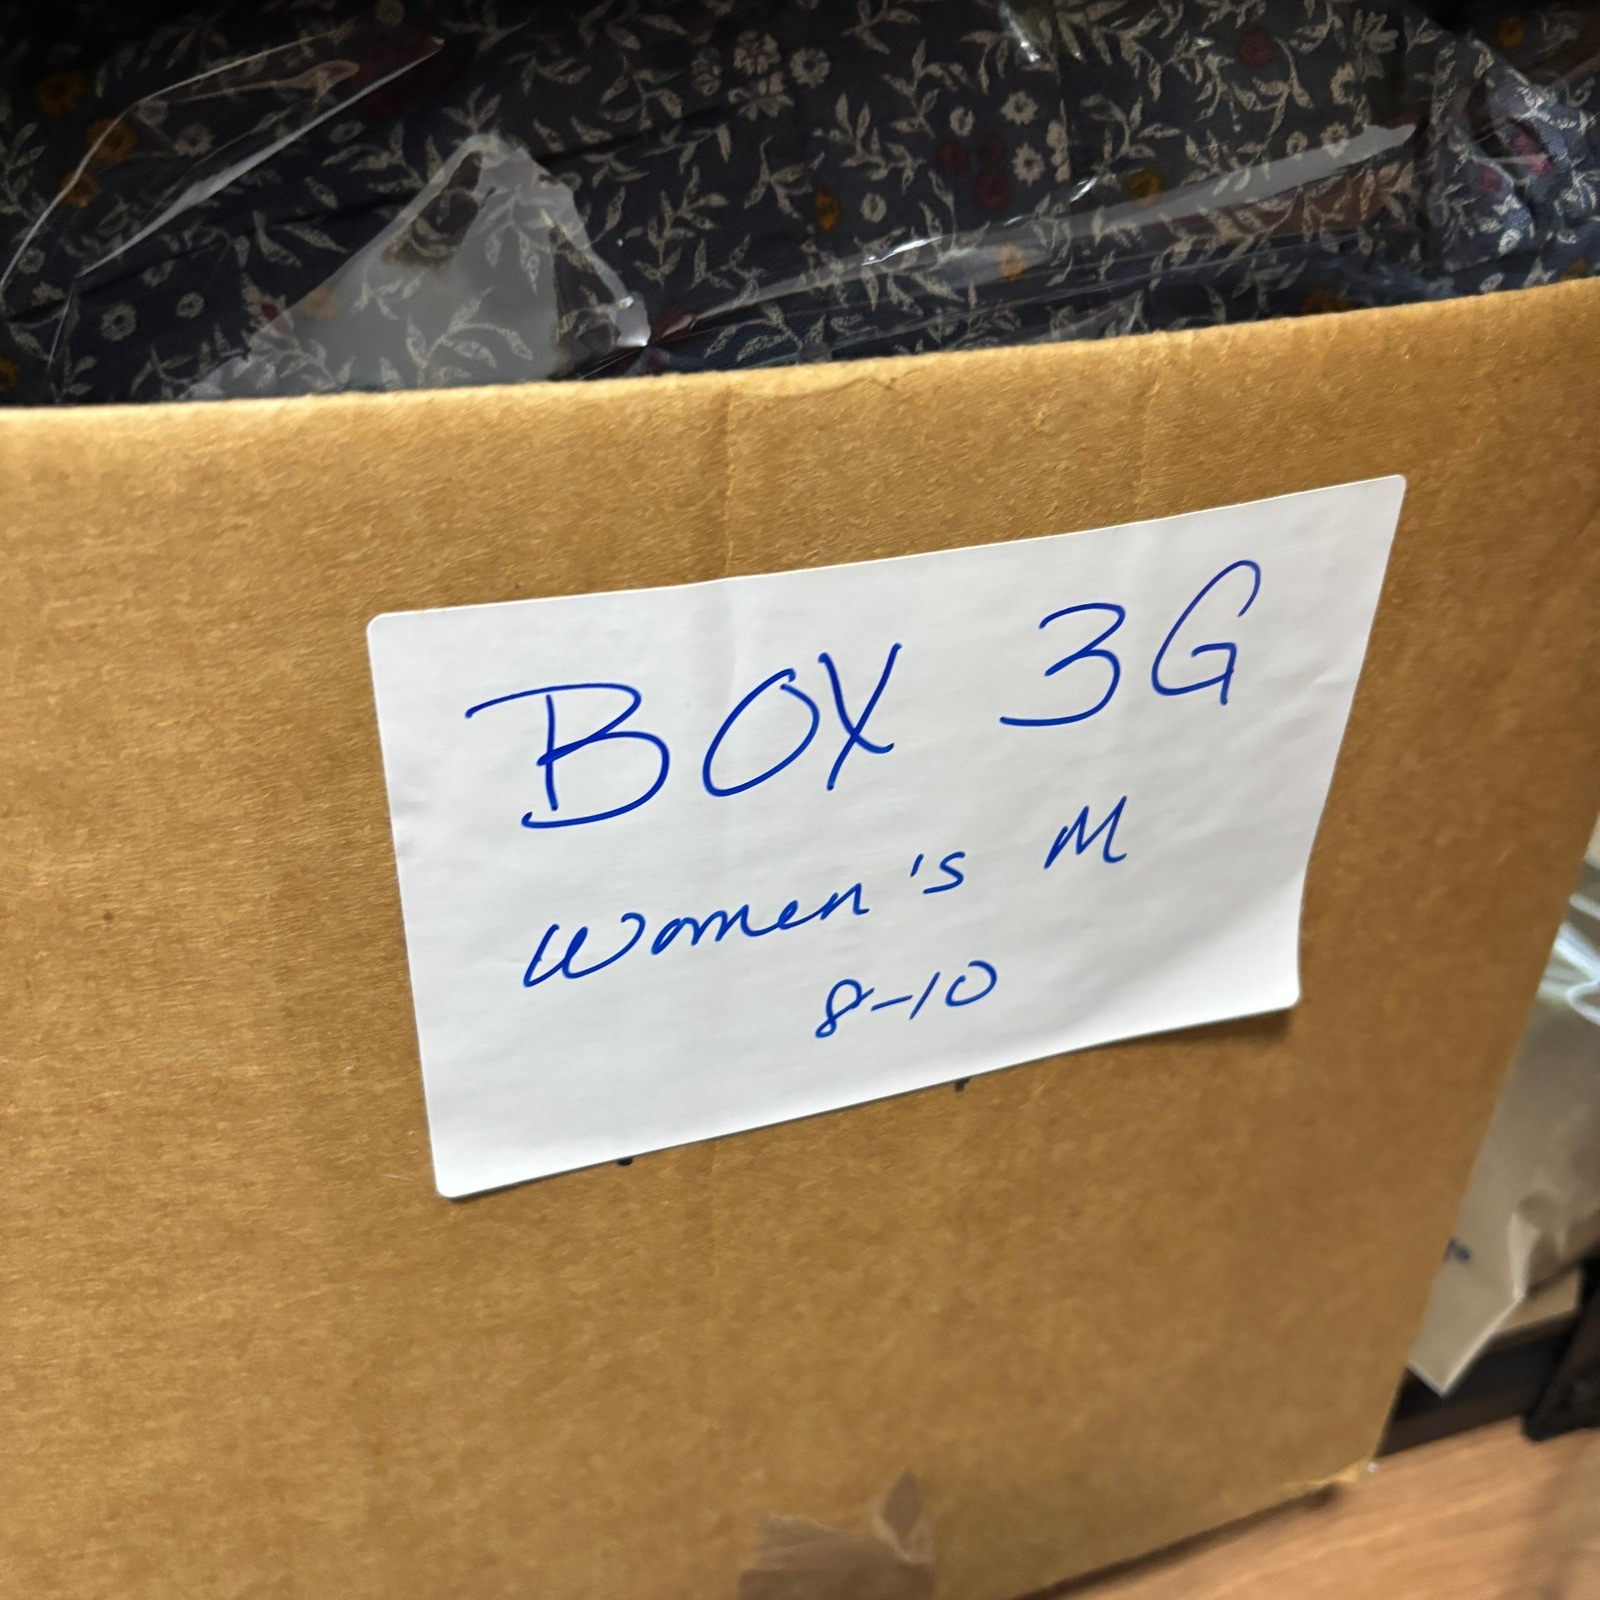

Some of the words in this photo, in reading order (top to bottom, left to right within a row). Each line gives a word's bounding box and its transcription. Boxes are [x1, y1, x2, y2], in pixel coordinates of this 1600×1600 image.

[464, 642, 903, 830] BOX
[999, 559, 1261, 727] 3G
[1043, 796, 1127, 869] M
[814, 960, 998, 1039] 8-10
